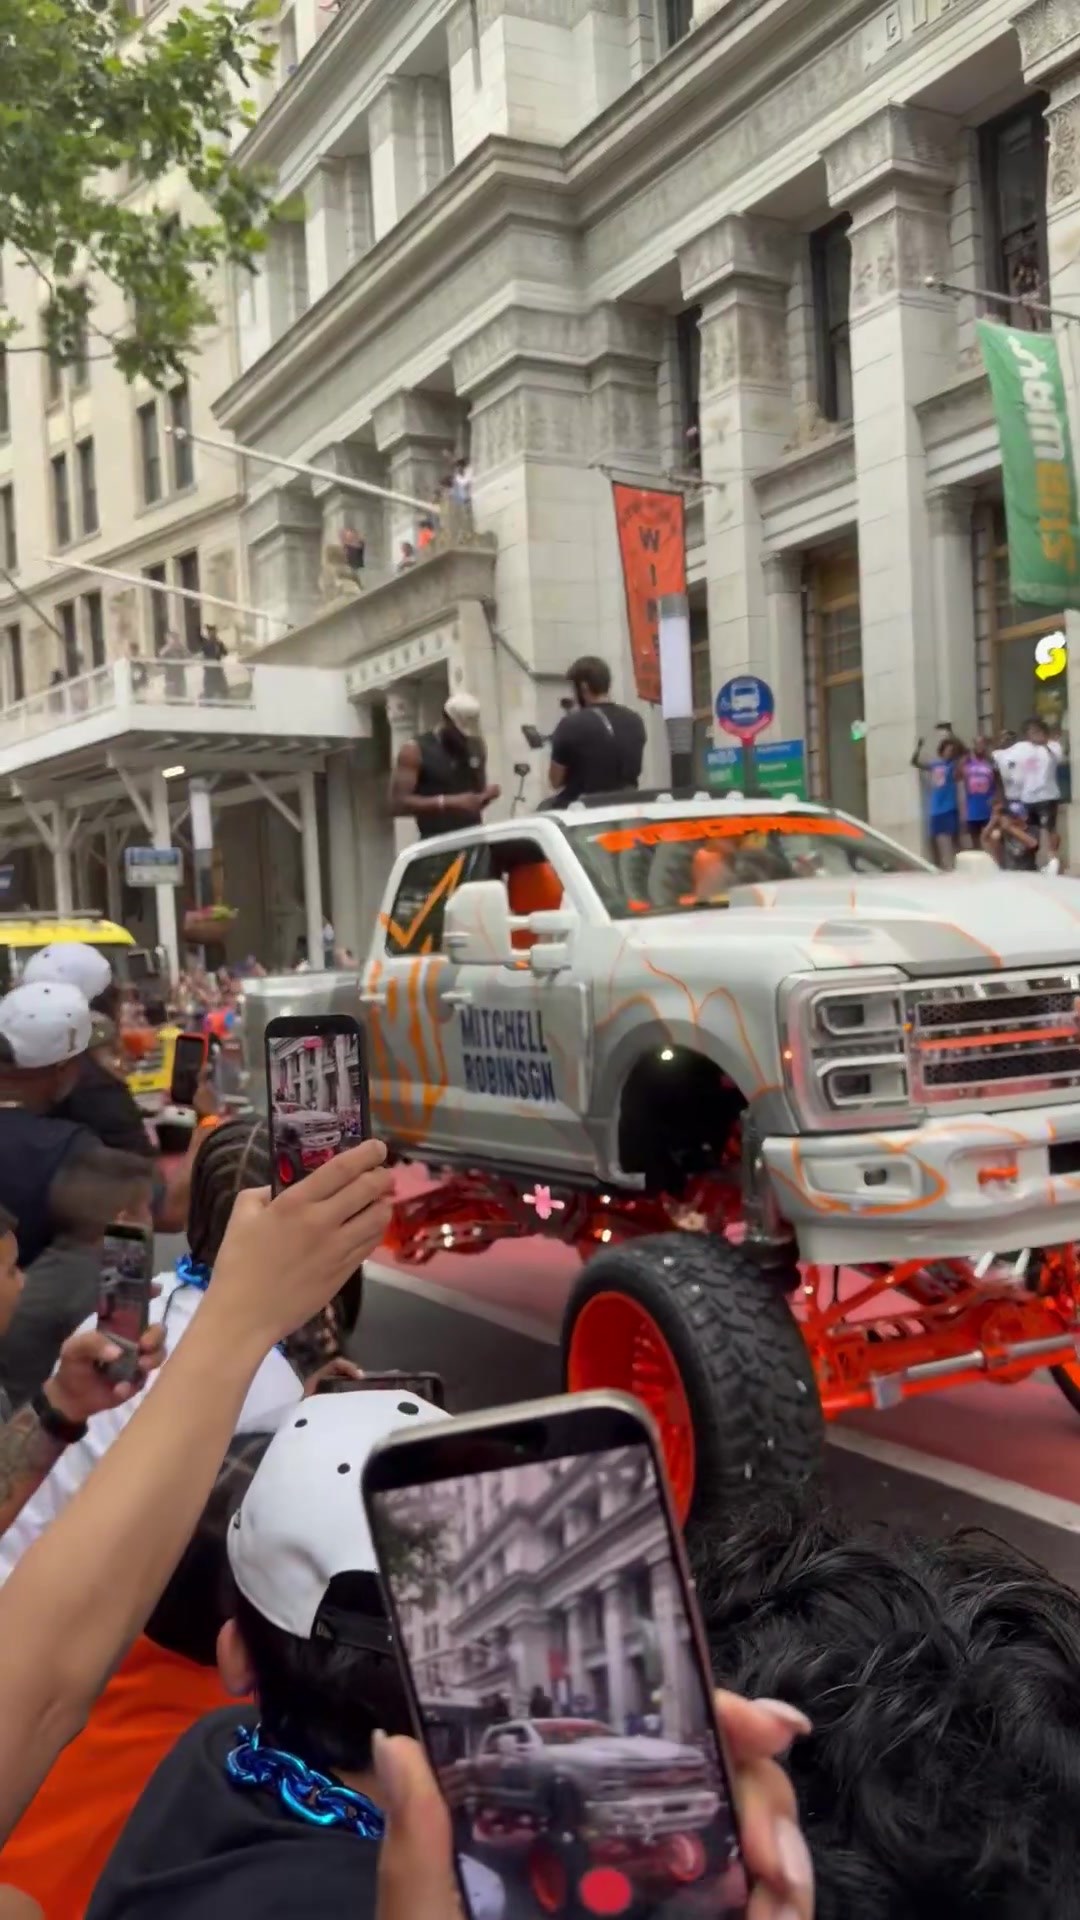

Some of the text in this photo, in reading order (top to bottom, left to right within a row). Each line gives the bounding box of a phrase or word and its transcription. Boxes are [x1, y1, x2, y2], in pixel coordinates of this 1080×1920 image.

[1007, 335, 1077, 574] SUBWAY
[1035, 631, 1066, 680] S
[460, 1006, 547, 1053] MITCHELL
[463, 1054, 556, 1103] ROBINSON
